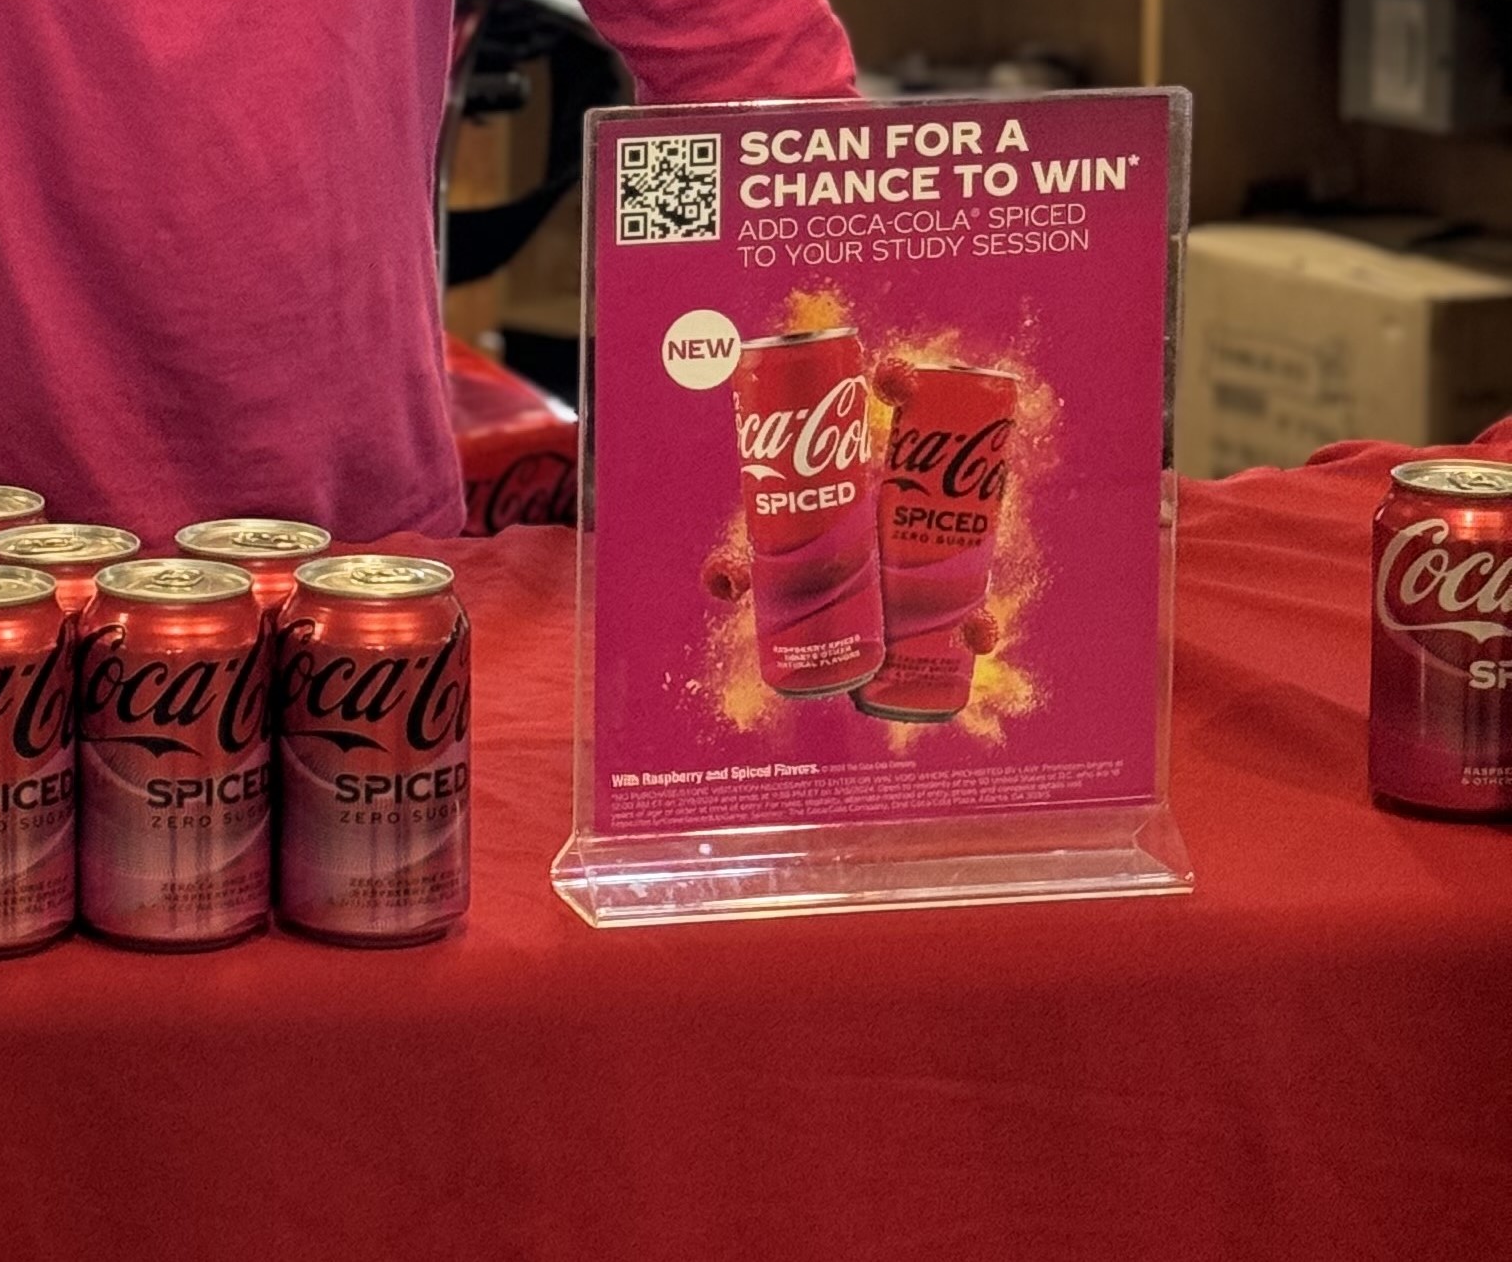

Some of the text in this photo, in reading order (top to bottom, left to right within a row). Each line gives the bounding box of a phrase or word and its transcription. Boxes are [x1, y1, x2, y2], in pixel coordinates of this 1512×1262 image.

[739, 119, 1029, 166] SCAN FOR A
[739, 167, 941, 209] CHANCE
[953, 163, 1018, 198] TO
[738, 219, 799, 241] ADD
[989, 203, 1087, 228] SPICED
[737, 229, 1089, 269] TO YOUR STUDY SESSION
[667, 339, 734, 362] NEW
[756, 481, 856, 515] SPICED
[893, 506, 987, 534] SPICED
[334, 762, 468, 806] SPICED
[612, 773, 639, 788] With
[642, 770, 704, 787] Raspberry
[705, 767, 729, 781] and
[731, 765, 771, 783] Spiced
[150, 814, 213, 830] ZERO
[339, 810, 401, 825] ZERO
